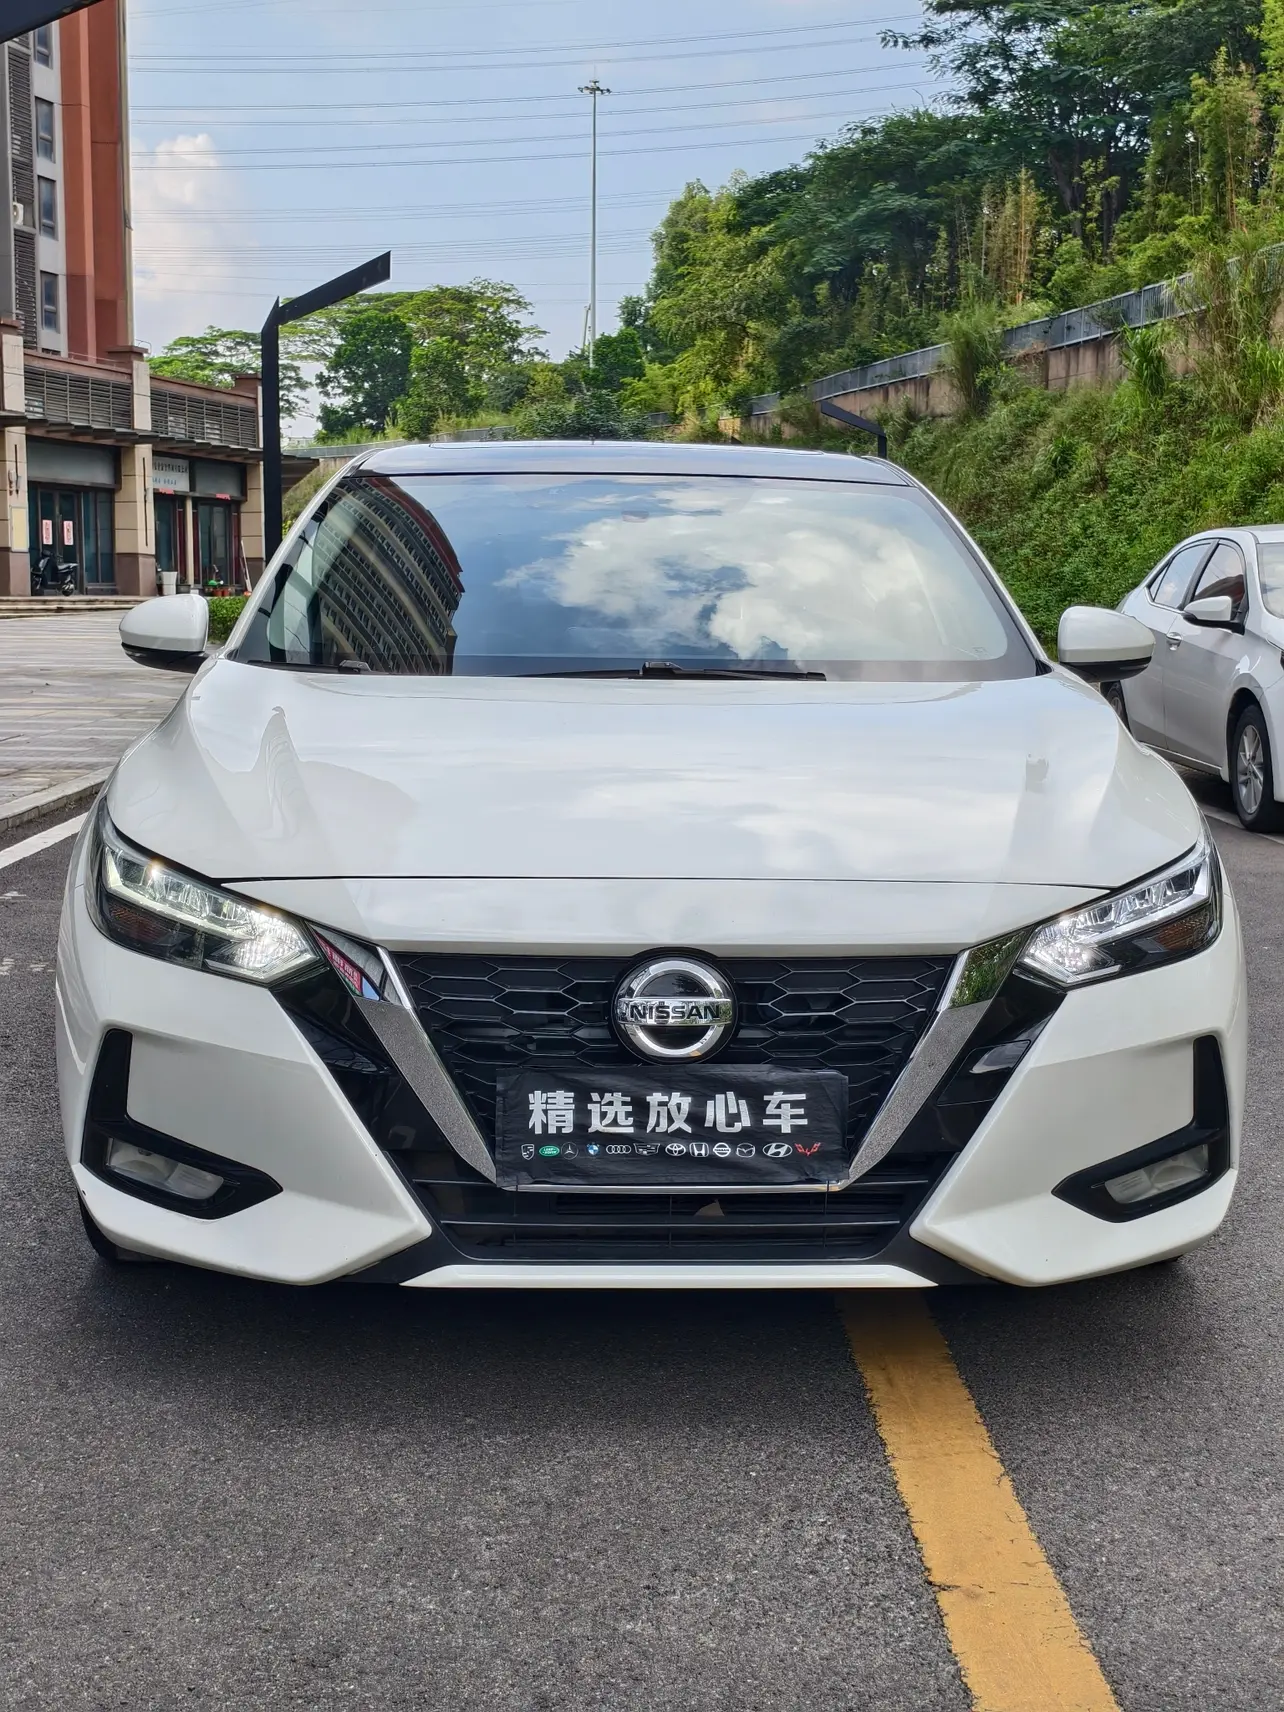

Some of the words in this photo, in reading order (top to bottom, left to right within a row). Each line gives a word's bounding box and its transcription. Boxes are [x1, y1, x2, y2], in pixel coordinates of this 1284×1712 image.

[629, 1004, 721, 1020] NISSAN
[528, 1090, 808, 1134] 精选放心车
